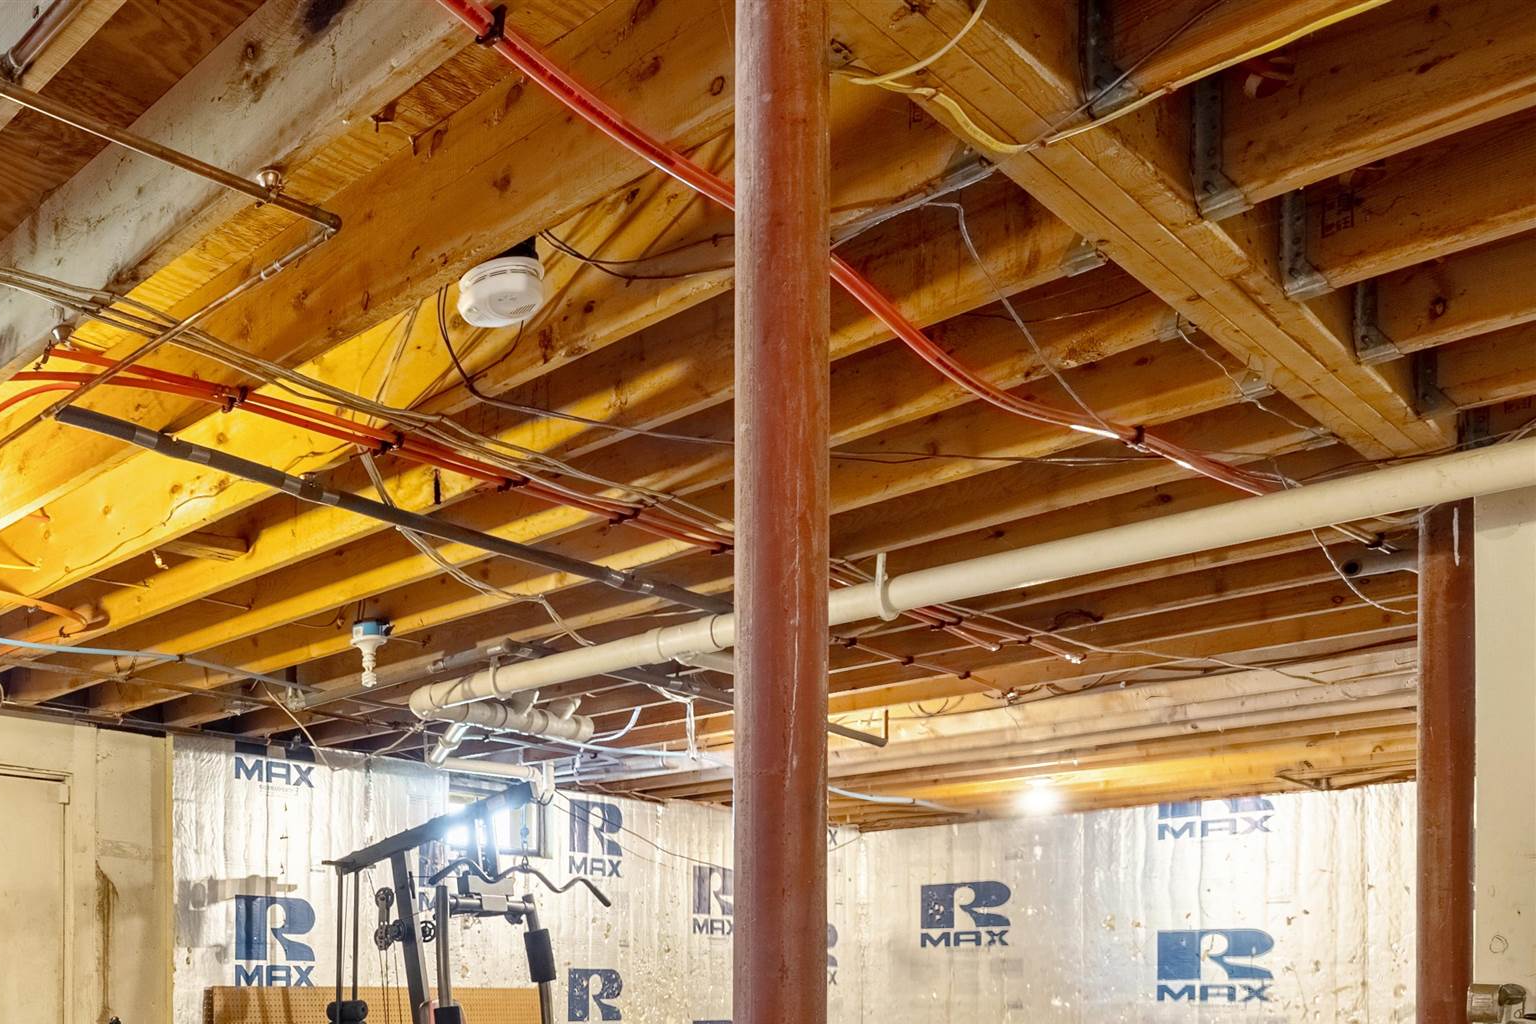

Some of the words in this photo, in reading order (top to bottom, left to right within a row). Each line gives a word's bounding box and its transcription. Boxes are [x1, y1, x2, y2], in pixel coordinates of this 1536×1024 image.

[235, 756, 314, 788] MAX
[569, 800, 622, 856] R
[1157, 815, 1272, 840] MAX
[568, 855, 622, 878] MAX
[921, 881, 1011, 929] R
[235, 895, 315, 961] R
[921, 930, 1008, 947] MAX
[1157, 928, 1274, 980] R
[235, 964, 315, 987] MAX
[568, 968, 622, 1022] R
[1157, 984, 1272, 1001] MAX
